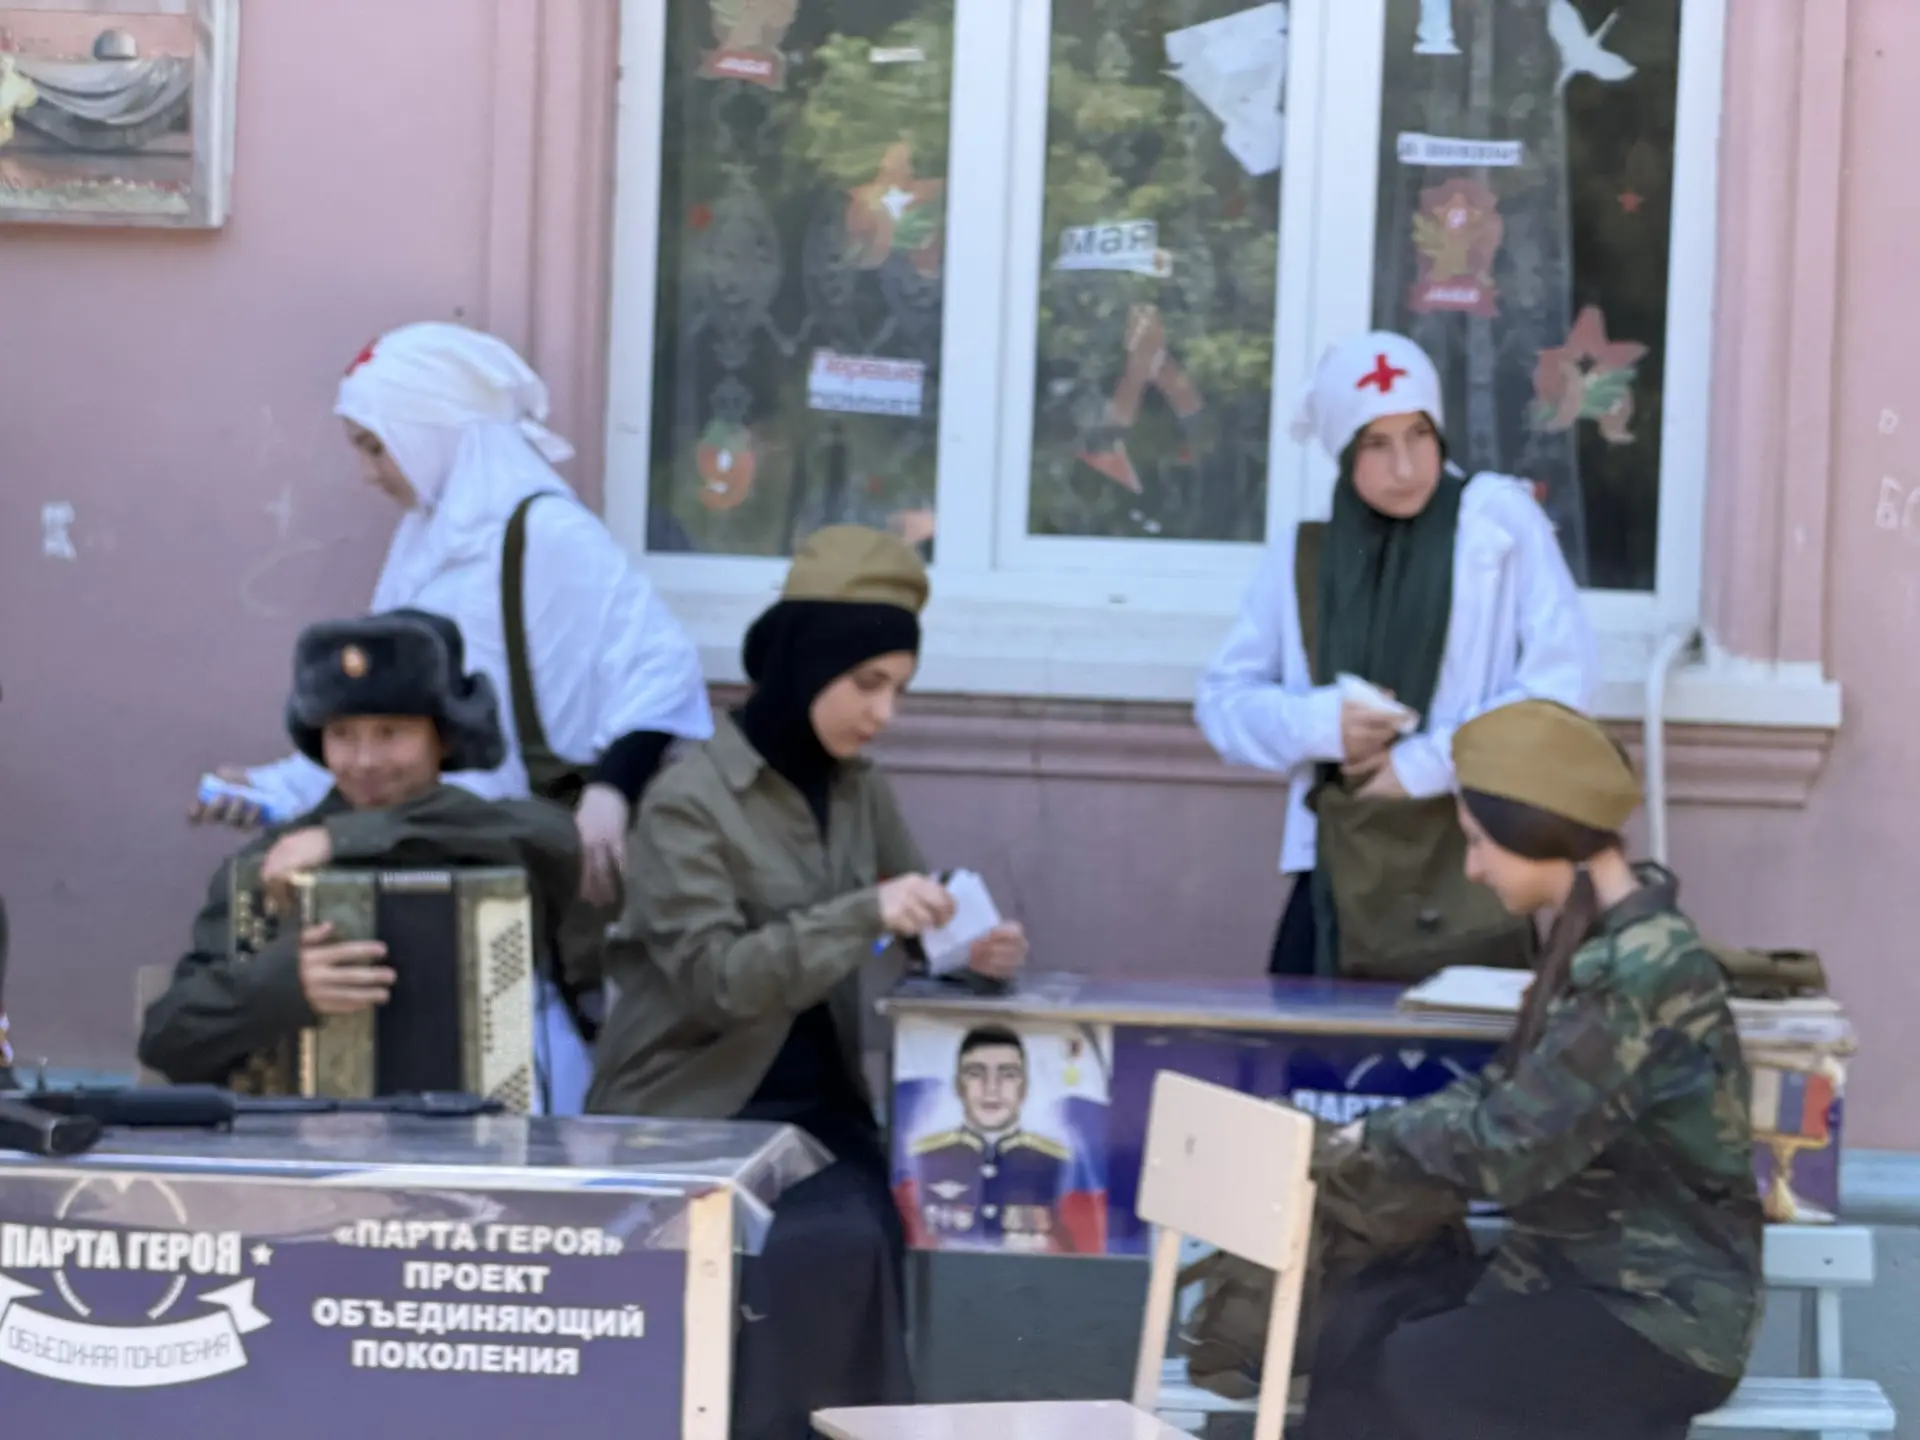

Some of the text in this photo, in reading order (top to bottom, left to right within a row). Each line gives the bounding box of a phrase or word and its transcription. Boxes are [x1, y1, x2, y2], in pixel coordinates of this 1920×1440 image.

[1, 1222, 242, 1276] ПАРТА ГЕРОЯ
[334, 1220, 624, 1256] «ПАРТА ГЕРОЯ»
[403, 1261, 550, 1293] ПРОЕКТ
[312, 1297, 645, 1341] ОБЪЕДИНЯЮЩИЙ
[352, 1339, 580, 1375] ПОКОЛЕНИЯ
